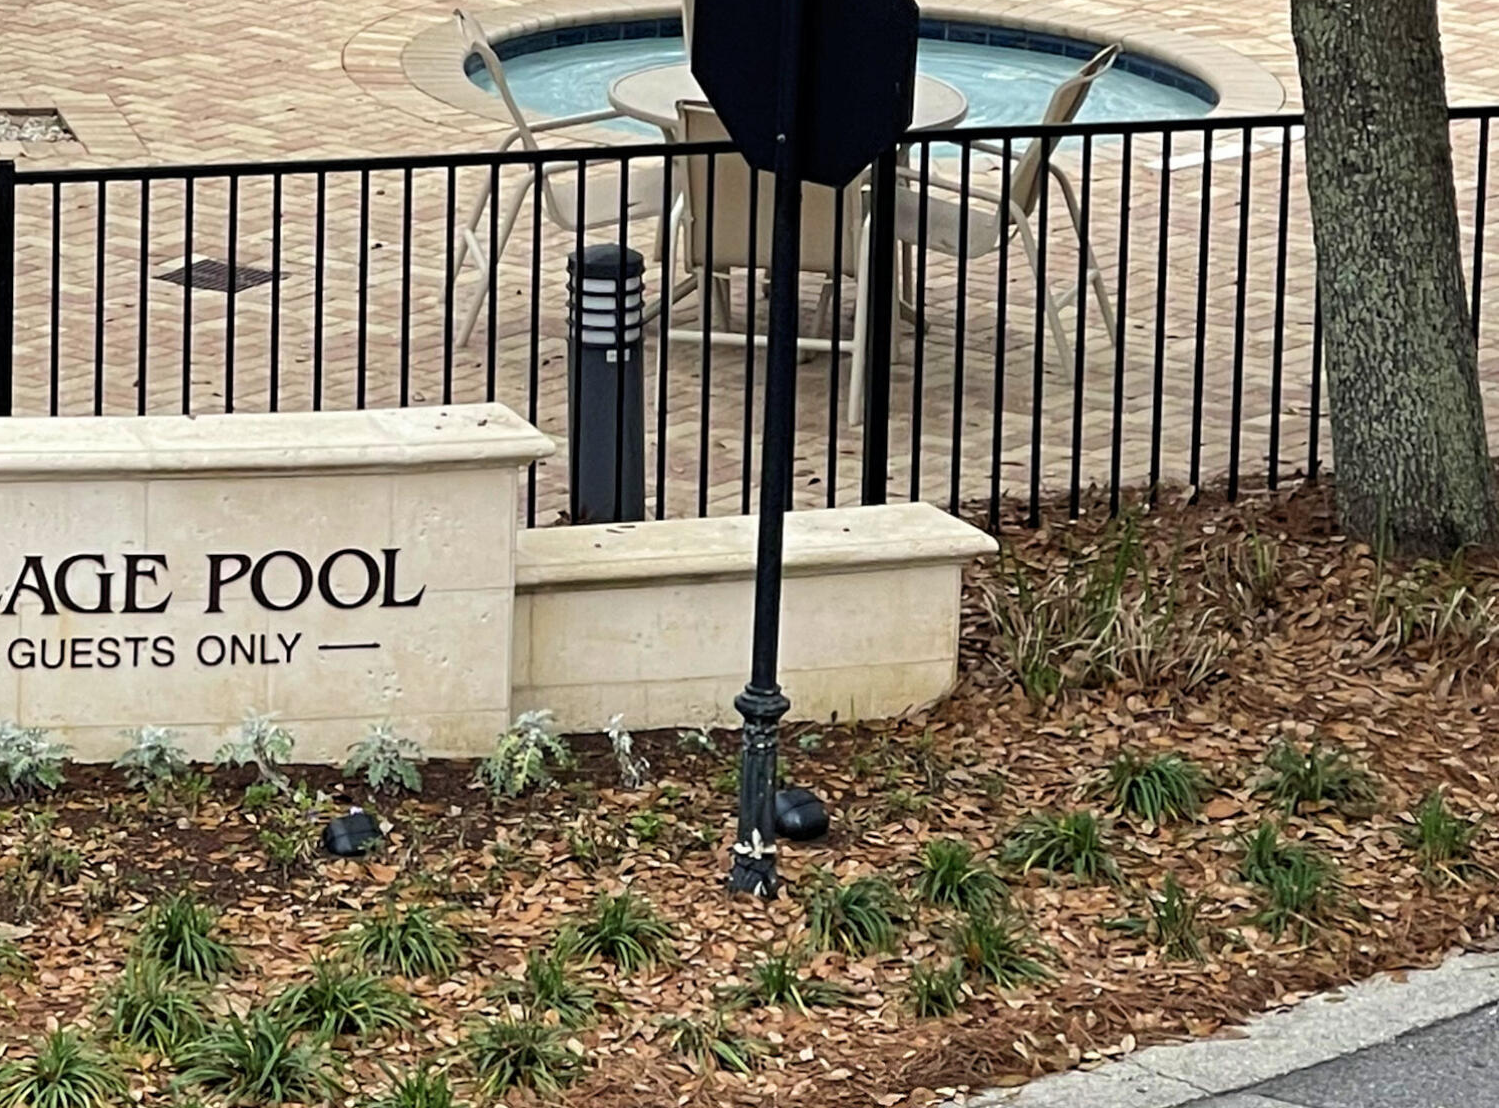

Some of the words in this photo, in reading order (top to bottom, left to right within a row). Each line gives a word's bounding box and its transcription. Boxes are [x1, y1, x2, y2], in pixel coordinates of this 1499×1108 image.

[205, 548, 426, 614] POOL
[7, 635, 175, 670] GUESTS
[196, 632, 302, 667] ONLY
